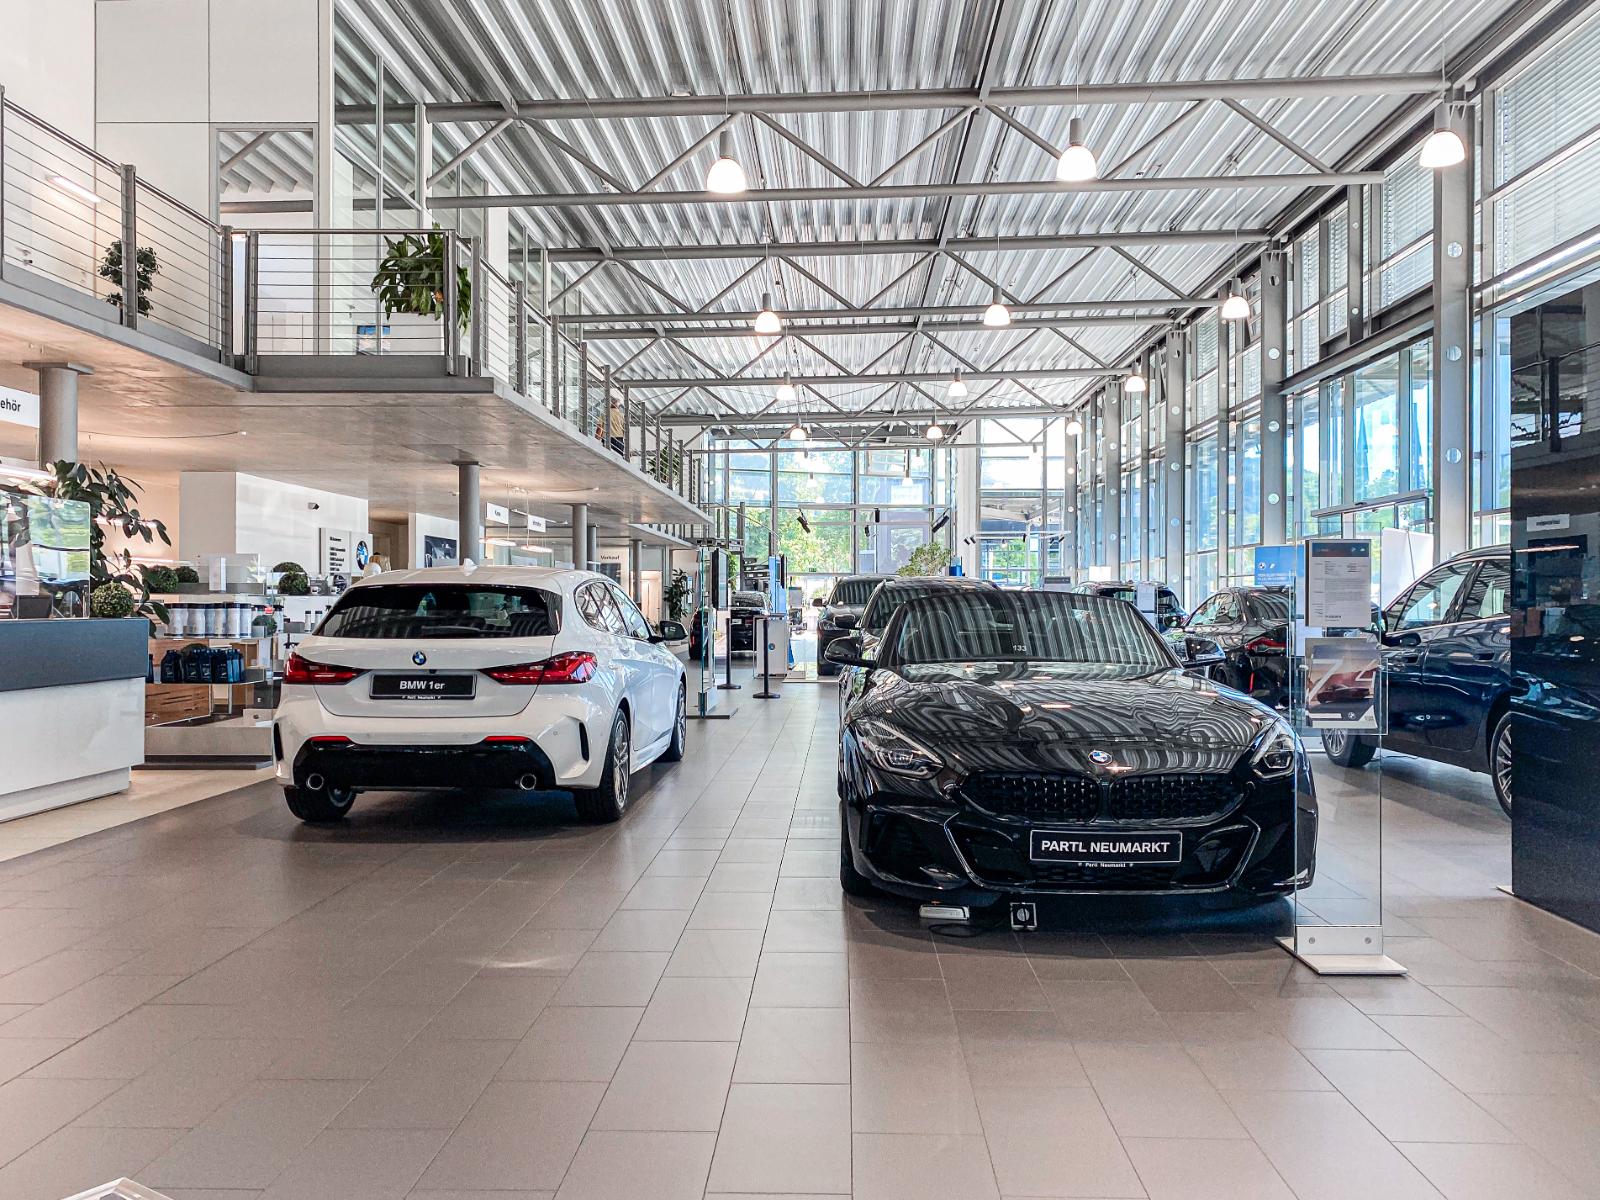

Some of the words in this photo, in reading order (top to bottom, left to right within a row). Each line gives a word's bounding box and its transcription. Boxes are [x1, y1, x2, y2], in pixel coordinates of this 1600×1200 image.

[400, 680, 427, 690] BMW
[429, 680, 445, 690] 1er
[1041, 840, 1087, 853] PARTL
[1090, 841, 1170, 853] NEUMARKT
